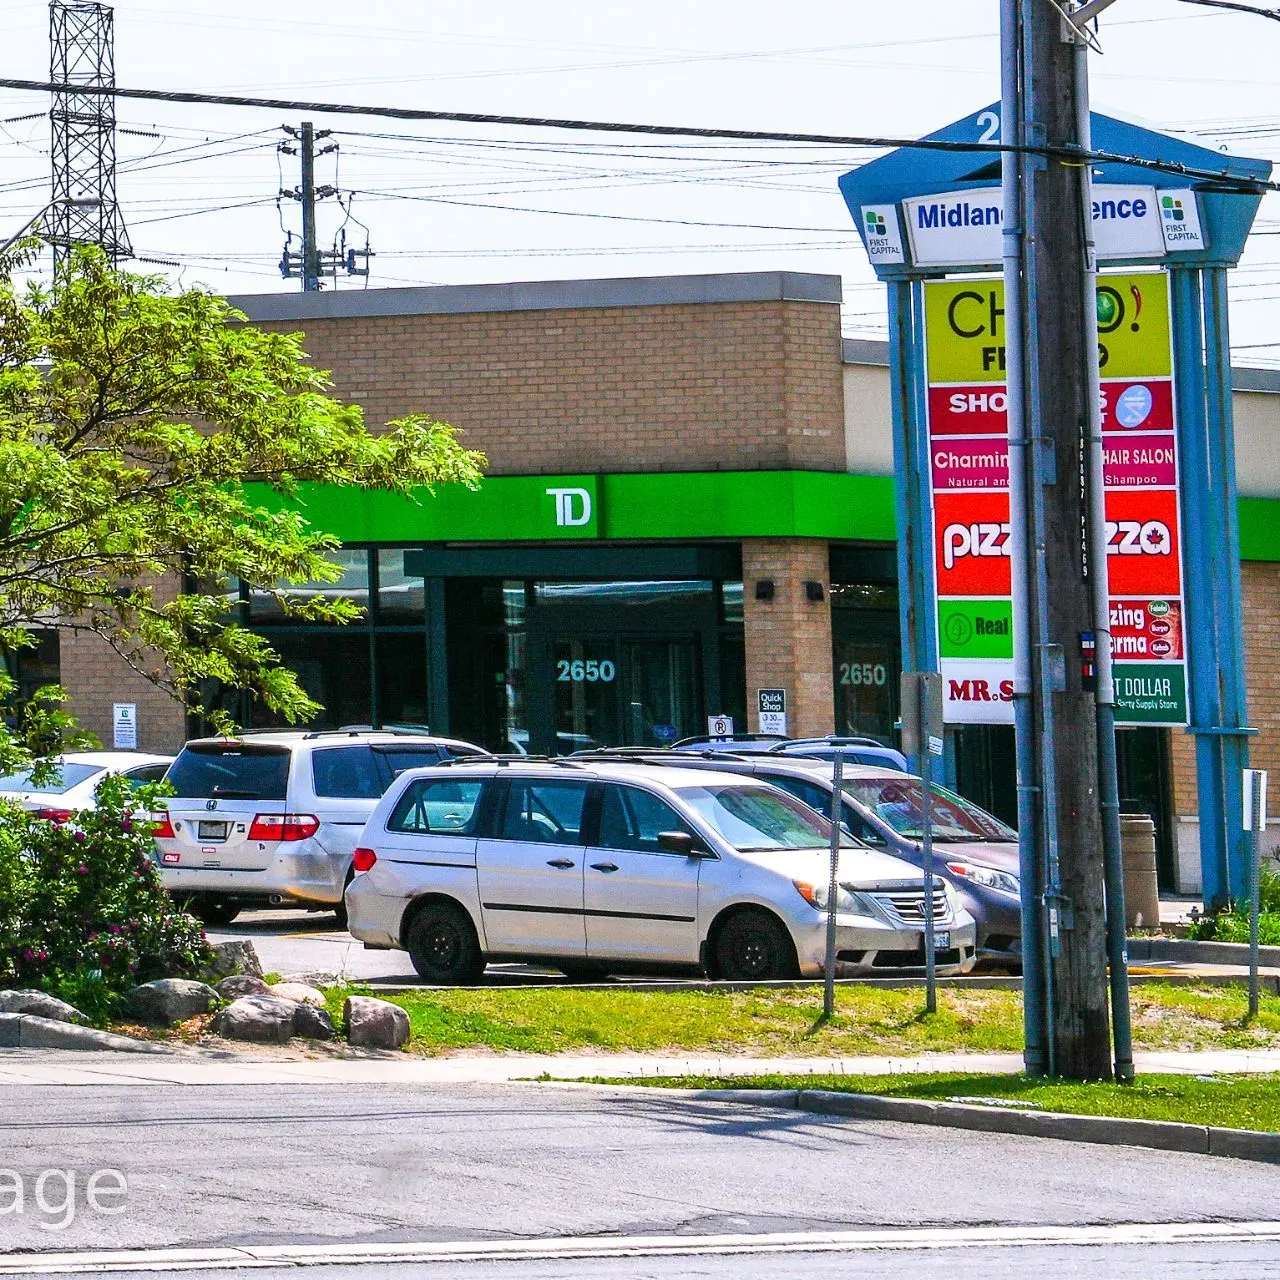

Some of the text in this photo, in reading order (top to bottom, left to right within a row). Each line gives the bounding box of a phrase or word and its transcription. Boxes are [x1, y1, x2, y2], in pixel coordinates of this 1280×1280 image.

[918, 202, 1003, 228] Midlan
[1166, 224, 1187, 232] FIRST
[1167, 232, 1199, 240] CAPITAL
[870, 238, 888, 246] FIRST
[870, 246, 900, 255] CAPITAL
[934, 451, 1009, 468] Charmin
[1103, 448, 1174, 464] HAIR SALON
[948, 477, 988, 487] Natural
[1105, 474, 1158, 485] Shampoo
[546, 488, 592, 526] TD
[943, 521, 1171, 570] pizz zza
[1110, 604, 1144, 630] zing
[976, 616, 1008, 636] Real
[556, 660, 615, 682] 2650
[840, 663, 886, 686] 2650
[949, 680, 1014, 702] MR.S
[1126, 678, 1171, 697] DOLLAR
[761, 693, 782, 702] Quick
[1136, 699, 1158, 710] Supply
[1160, 700, 1178, 709] Store
[763, 702, 781, 711] Shop
